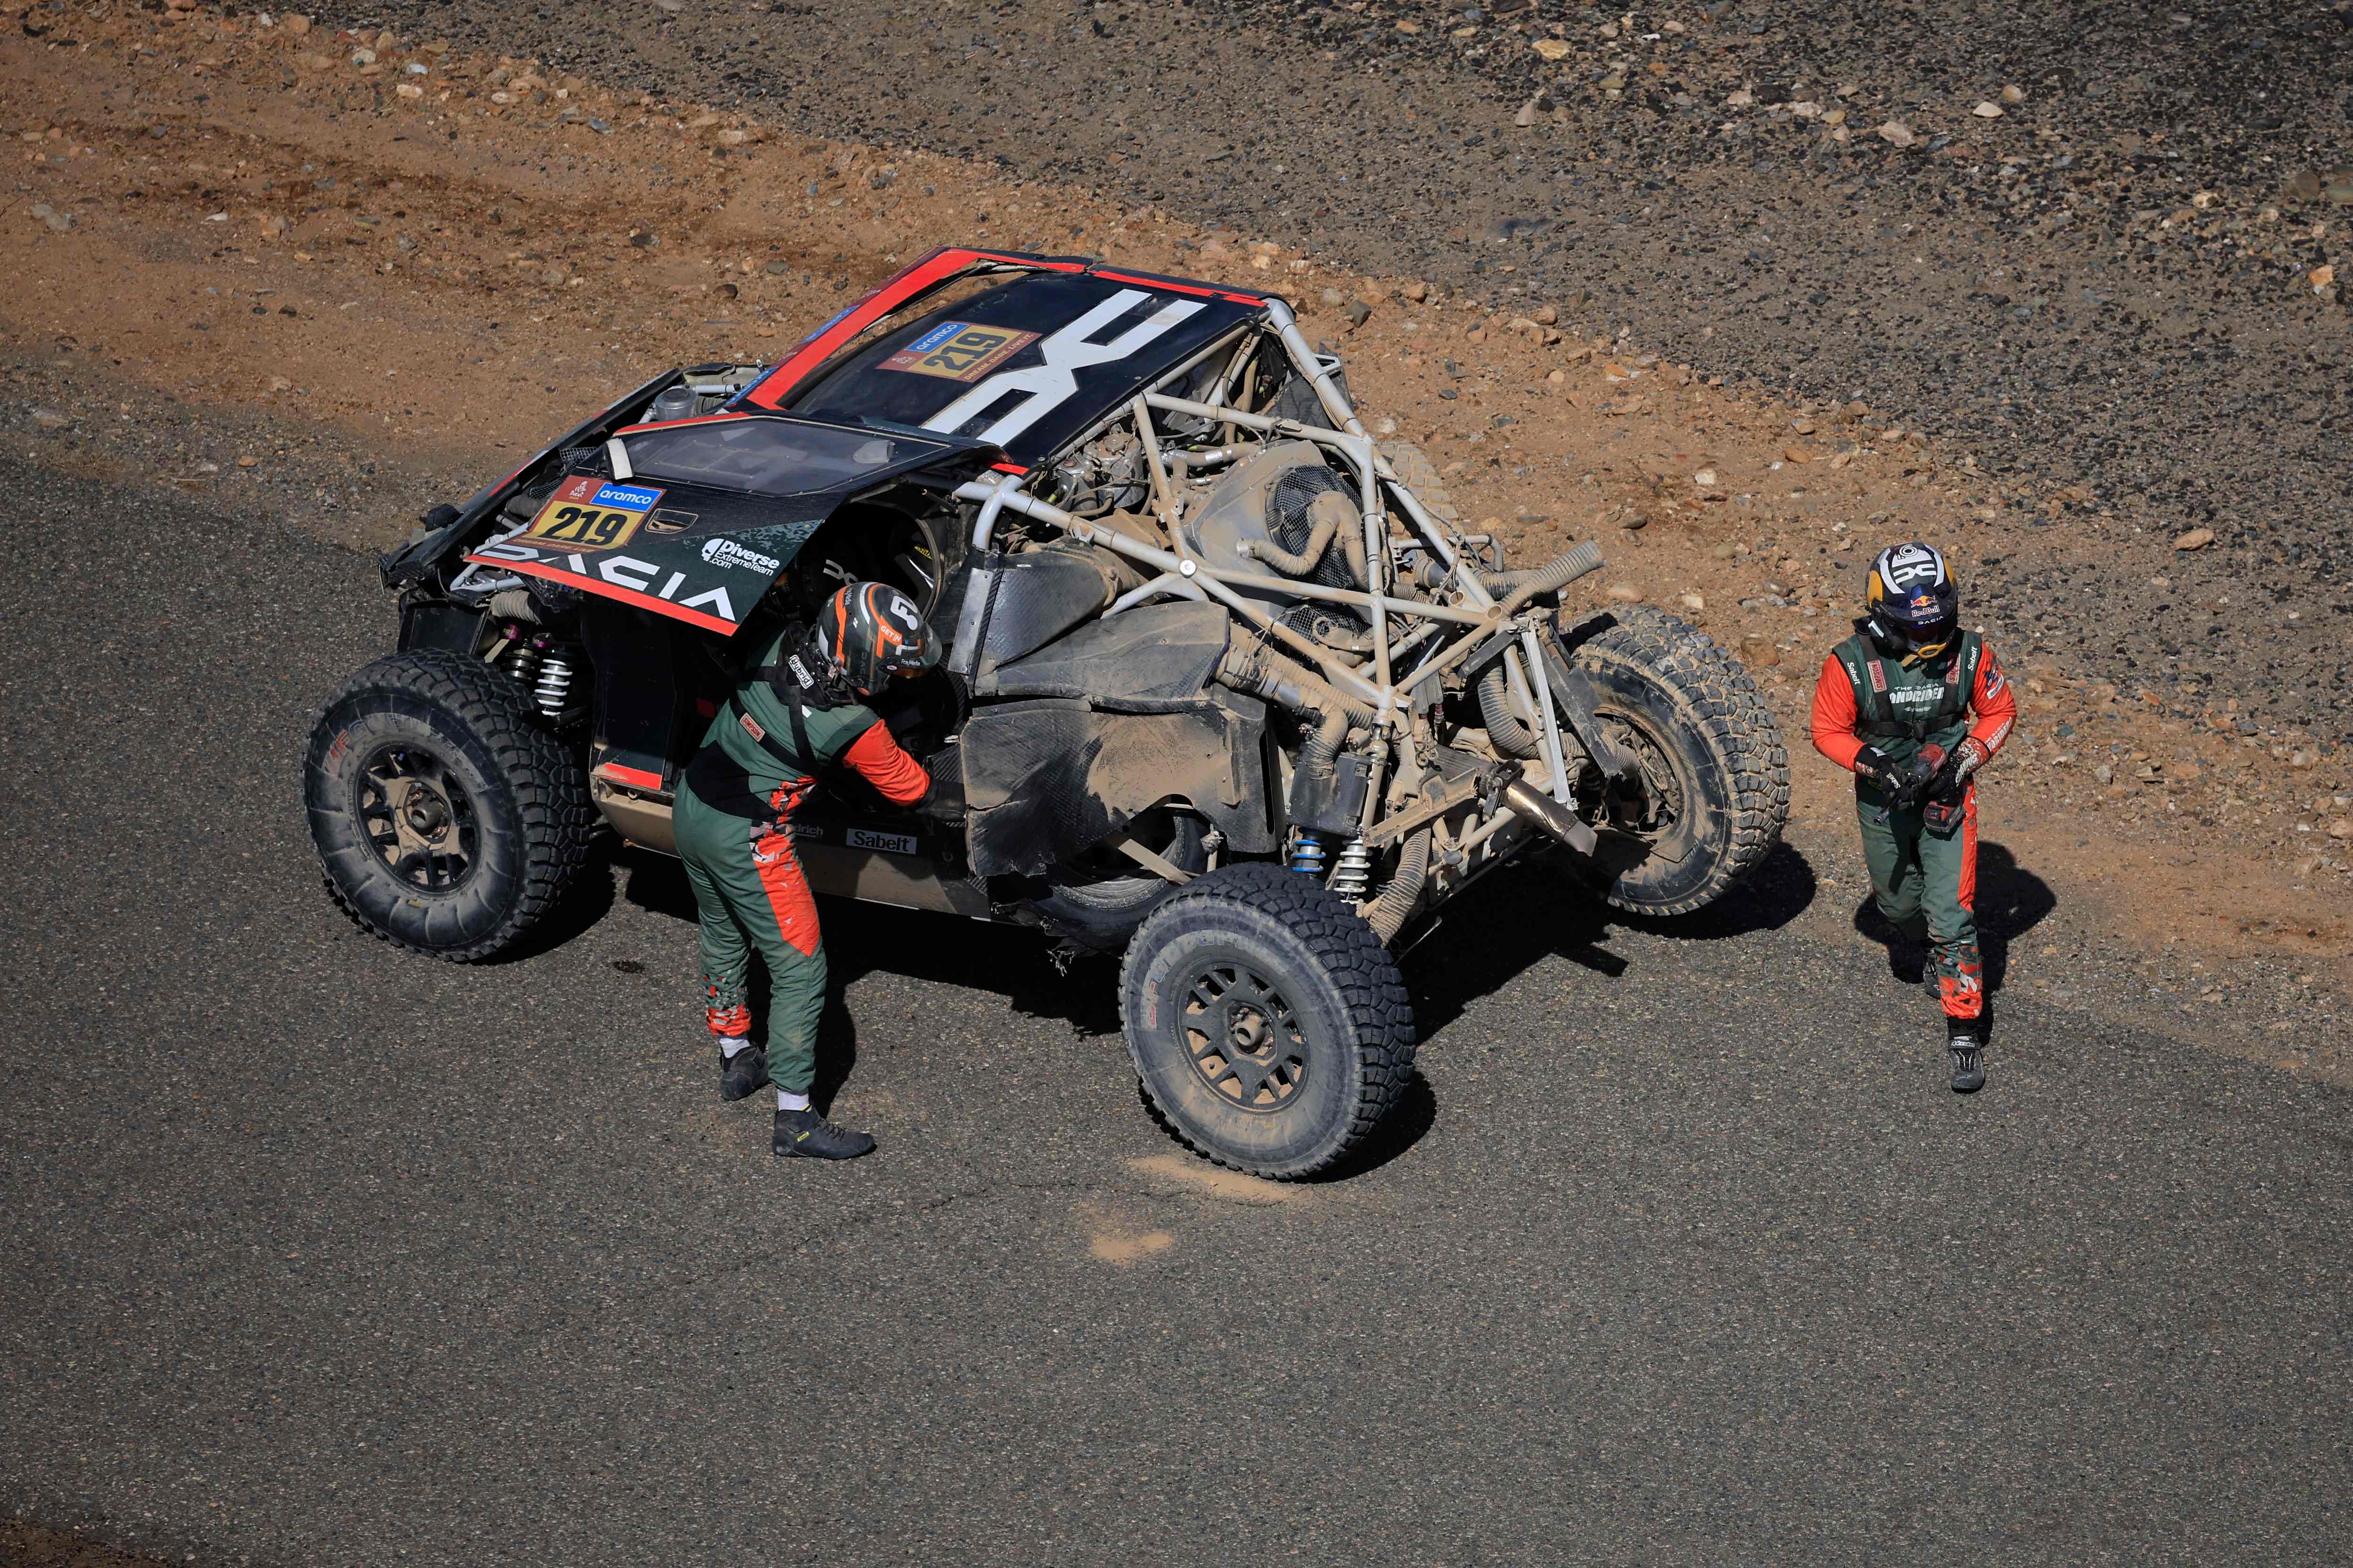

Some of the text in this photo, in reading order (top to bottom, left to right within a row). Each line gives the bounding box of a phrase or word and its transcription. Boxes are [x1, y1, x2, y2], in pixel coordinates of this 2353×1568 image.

[916, 324, 958, 350] aramco
[923, 332, 1007, 371] 219
[964, 363, 990, 380] DREAM.
[993, 350, 1011, 363] DARE.
[1010, 338, 1024, 350] LIVE
[599, 489, 651, 505] aramco
[537, 507, 628, 546] 219
[709, 557, 732, 569] .com
[714, 550, 774, 576] ExtremeTeam
[720, 540, 779, 569] Diverse
[479, 544, 736, 621] DACIA
[881, 626, 895, 638] GET
[1918, 616, 1944, 625] DACIA
[1968, 646, 1977, 671] Sabelt
[790, 658, 811, 686] Hybrid
[1847, 662, 1861, 685] Sabelt
[1871, 664, 1883, 690] SIMPSON
[743, 717, 761, 737] SIMPSON
[1886, 772, 1901, 789] Sabelt
[853, 831, 910, 852] Sabelt
